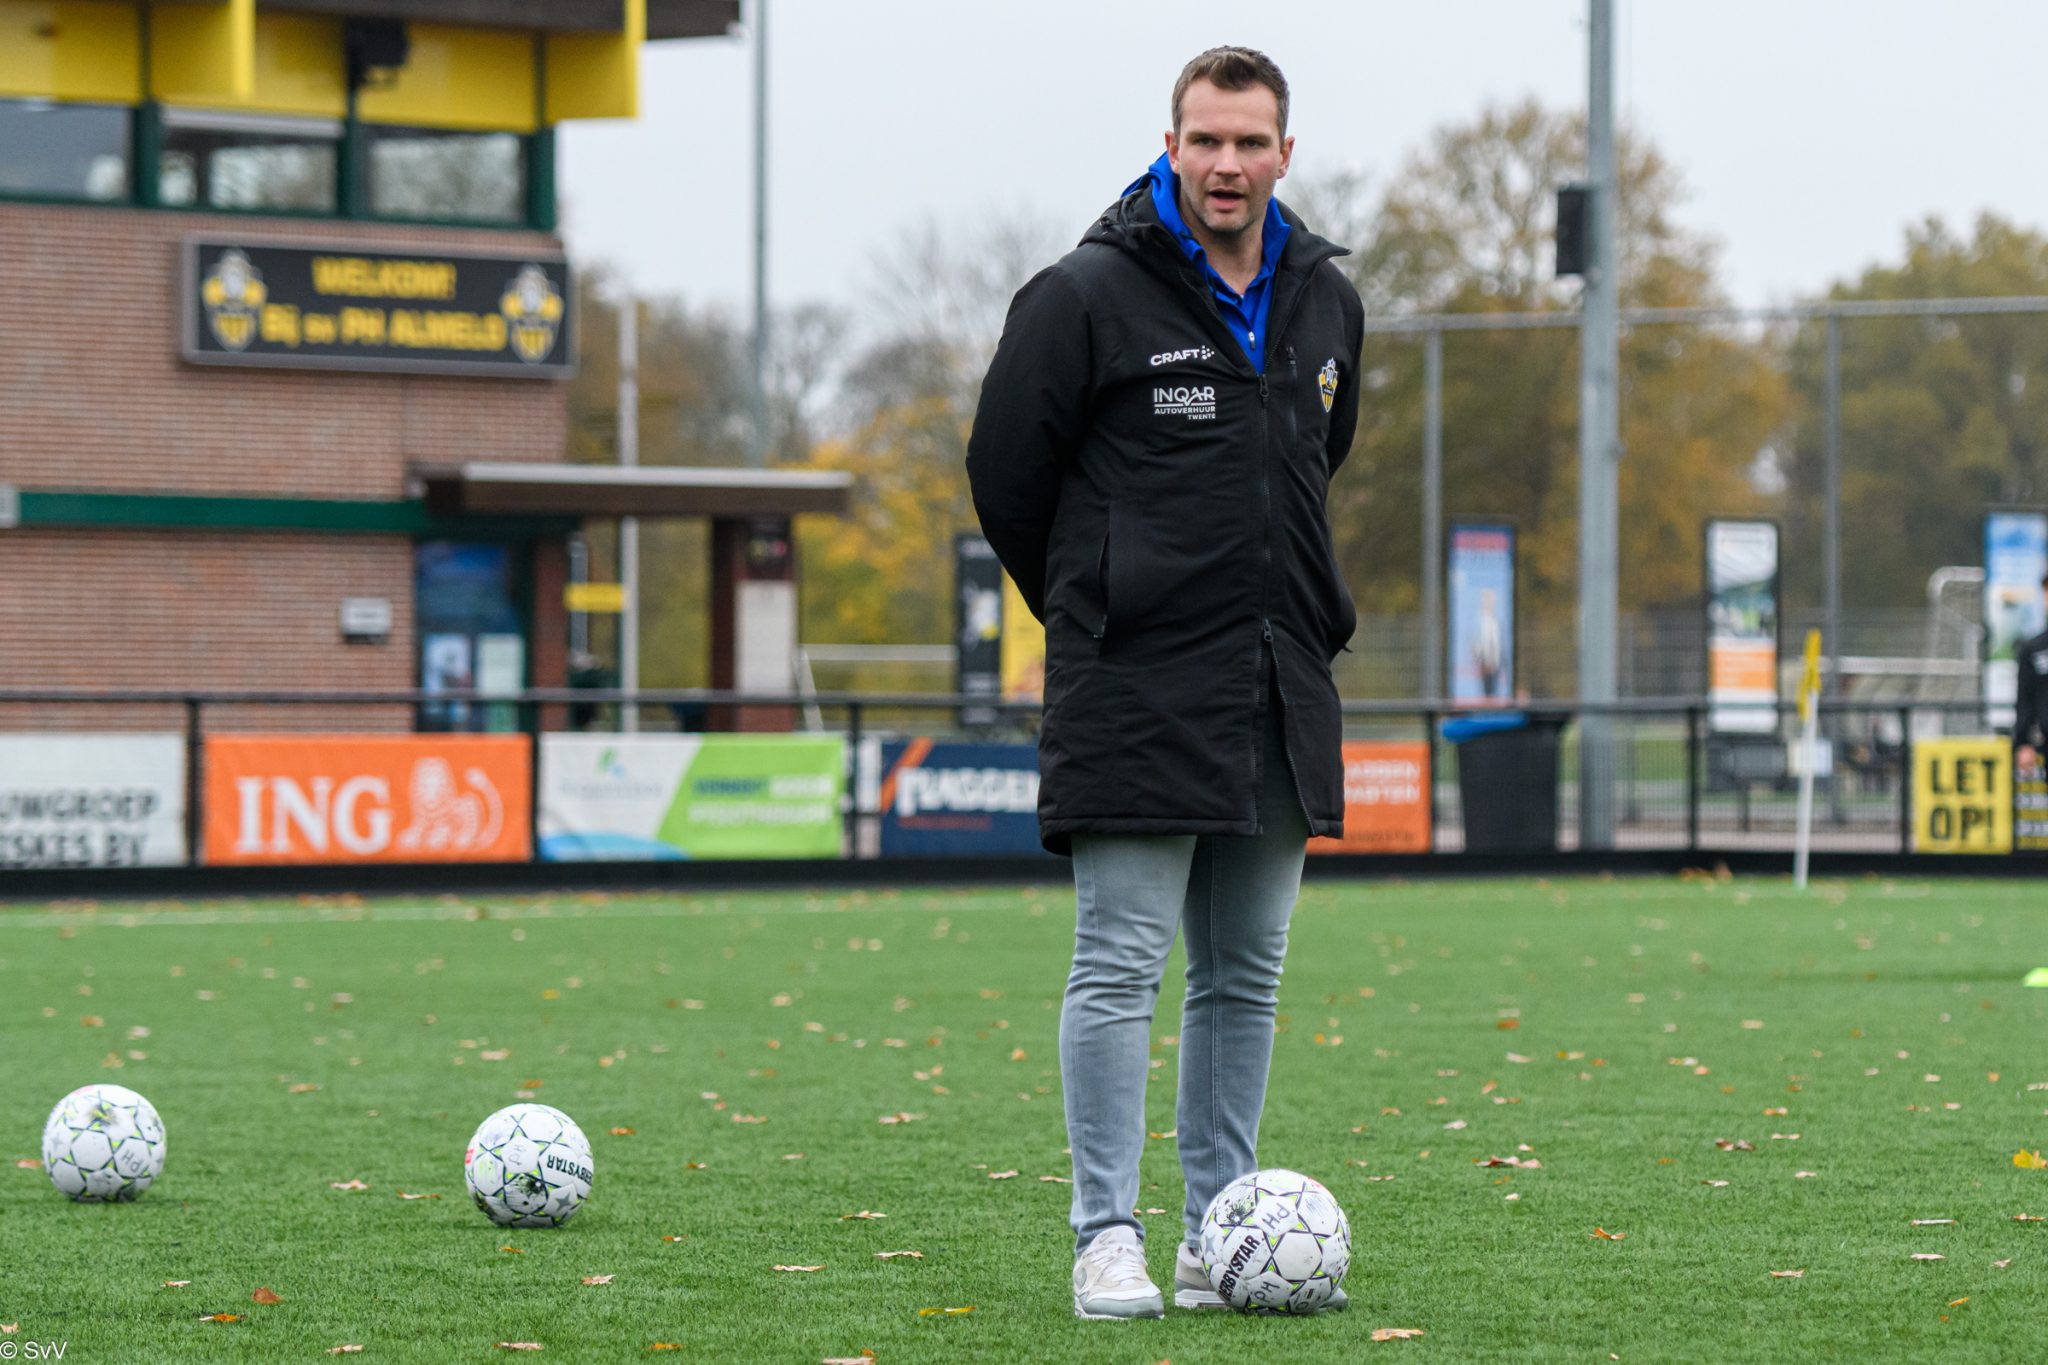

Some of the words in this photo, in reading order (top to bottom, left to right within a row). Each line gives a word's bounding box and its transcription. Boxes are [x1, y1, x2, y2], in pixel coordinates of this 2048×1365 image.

[388, 310, 508, 351] ALMELO
[1150, 348, 1200, 366] CRAFT
[1153, 386, 1216, 406] INQAR
[1154, 406, 1216, 415] AUTOVERHUUR
[1931, 758, 1999, 795] LET
[235, 774, 393, 855] ING
[1930, 806, 1994, 843] OP!
